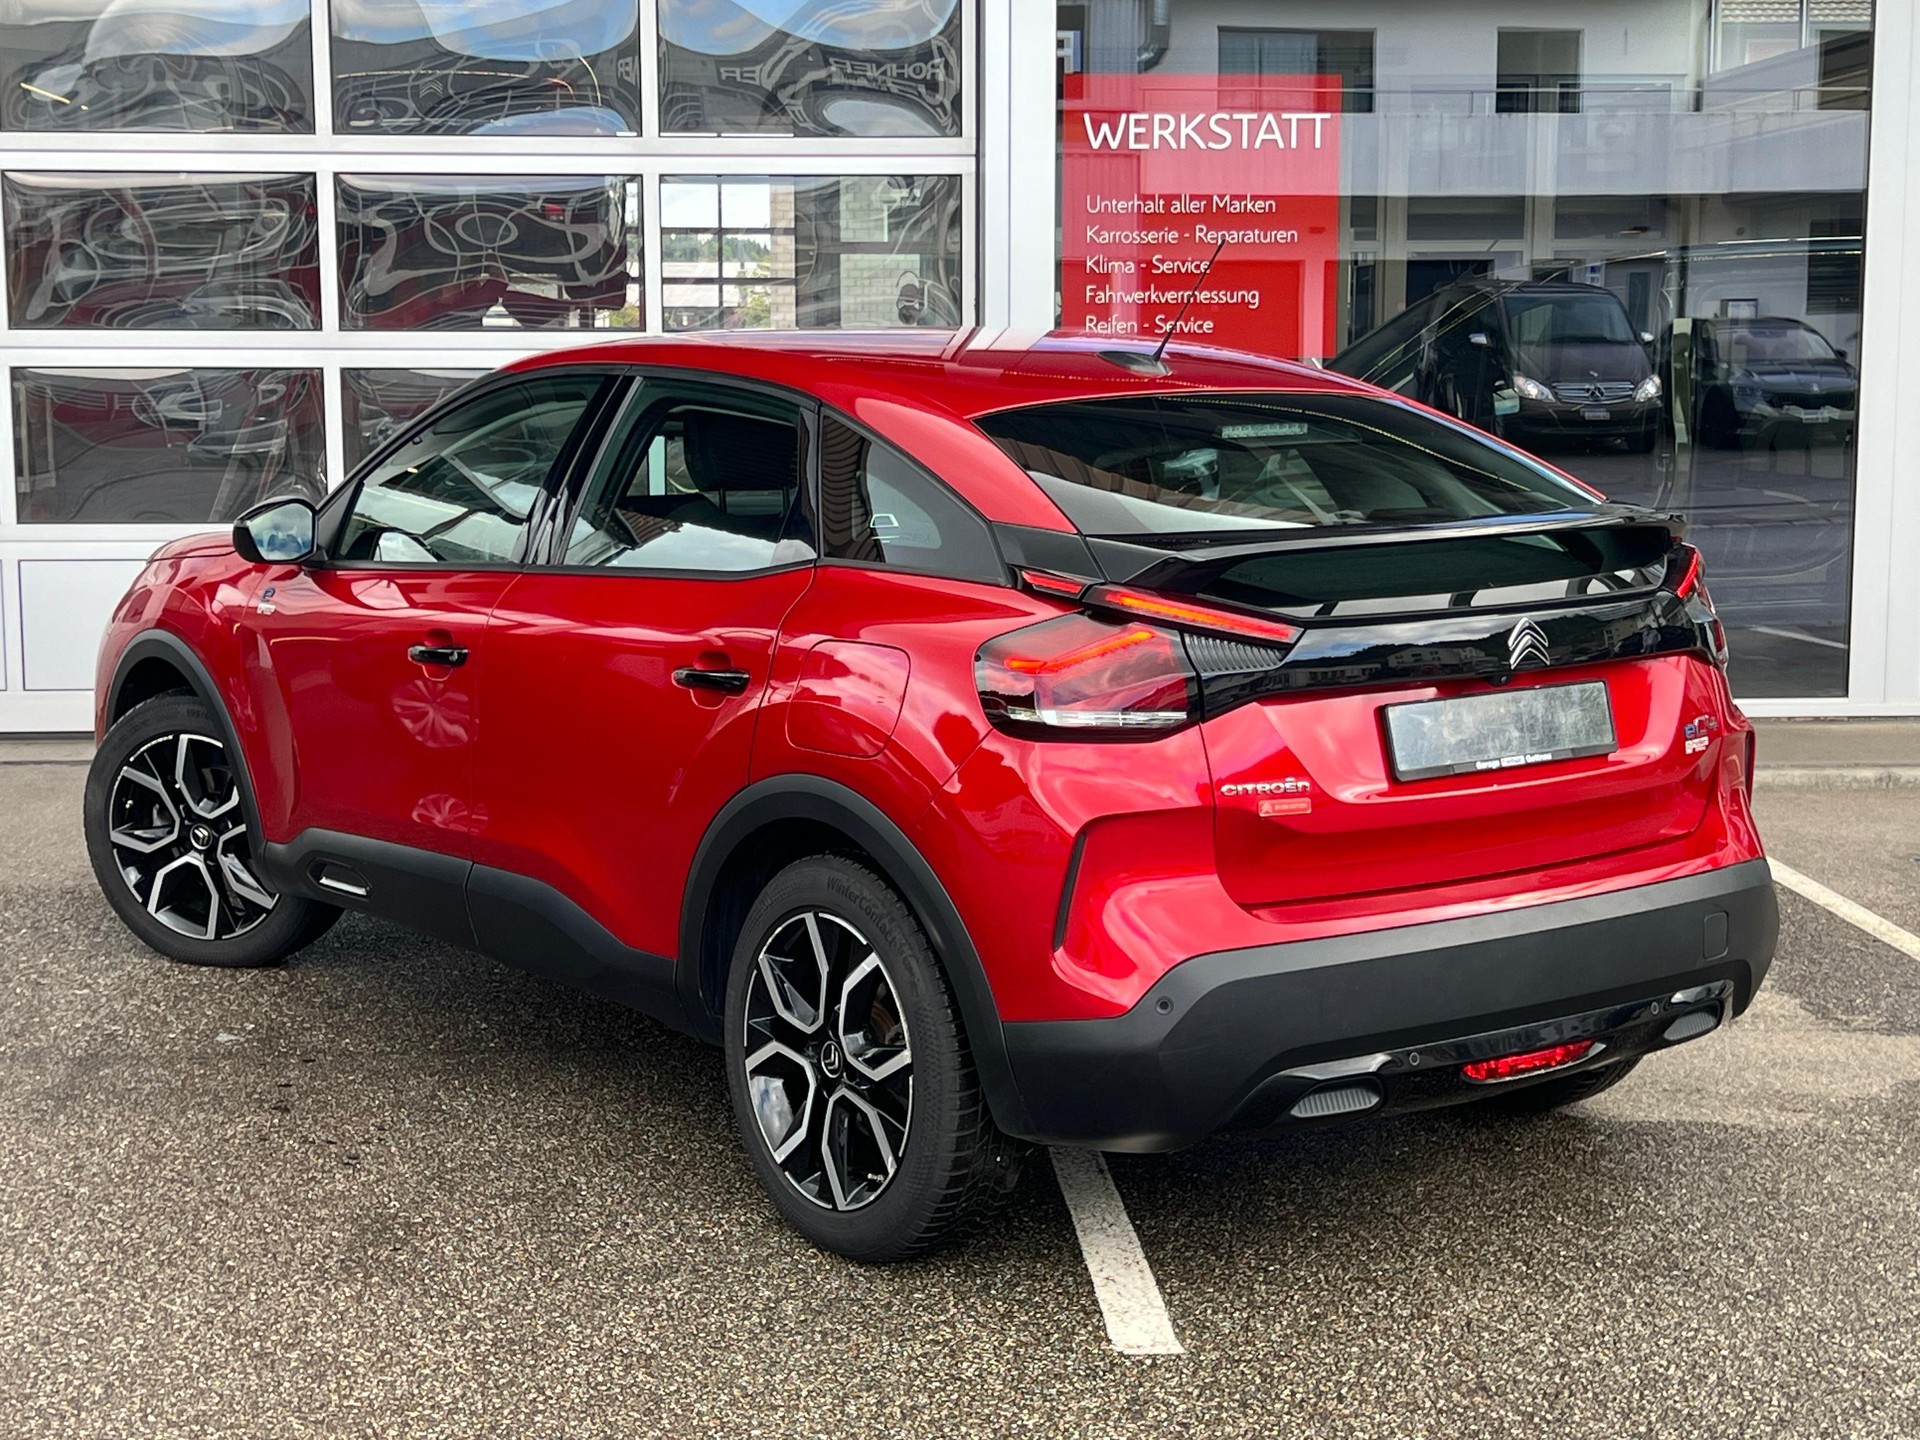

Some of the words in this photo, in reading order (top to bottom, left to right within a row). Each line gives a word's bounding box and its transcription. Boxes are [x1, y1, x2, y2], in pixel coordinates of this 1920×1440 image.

[1083, 113, 1331, 150] WERKSTATT
[1086, 194, 1165, 214] Unterhalt
[1170, 194, 1206, 214] aller
[1212, 194, 1276, 214] Marken
[1086, 225, 1179, 244] Karrosserie
[1195, 225, 1298, 248] Reparaturen
[1086, 255, 1135, 274] Klima
[1151, 255, 1211, 274] Service
[1085, 284, 1260, 308] Fahrwerkvermessung
[1085, 315, 1138, 334] Reifen
[1154, 315, 1214, 334] Service
[1220, 776, 1311, 796] CITROËN
